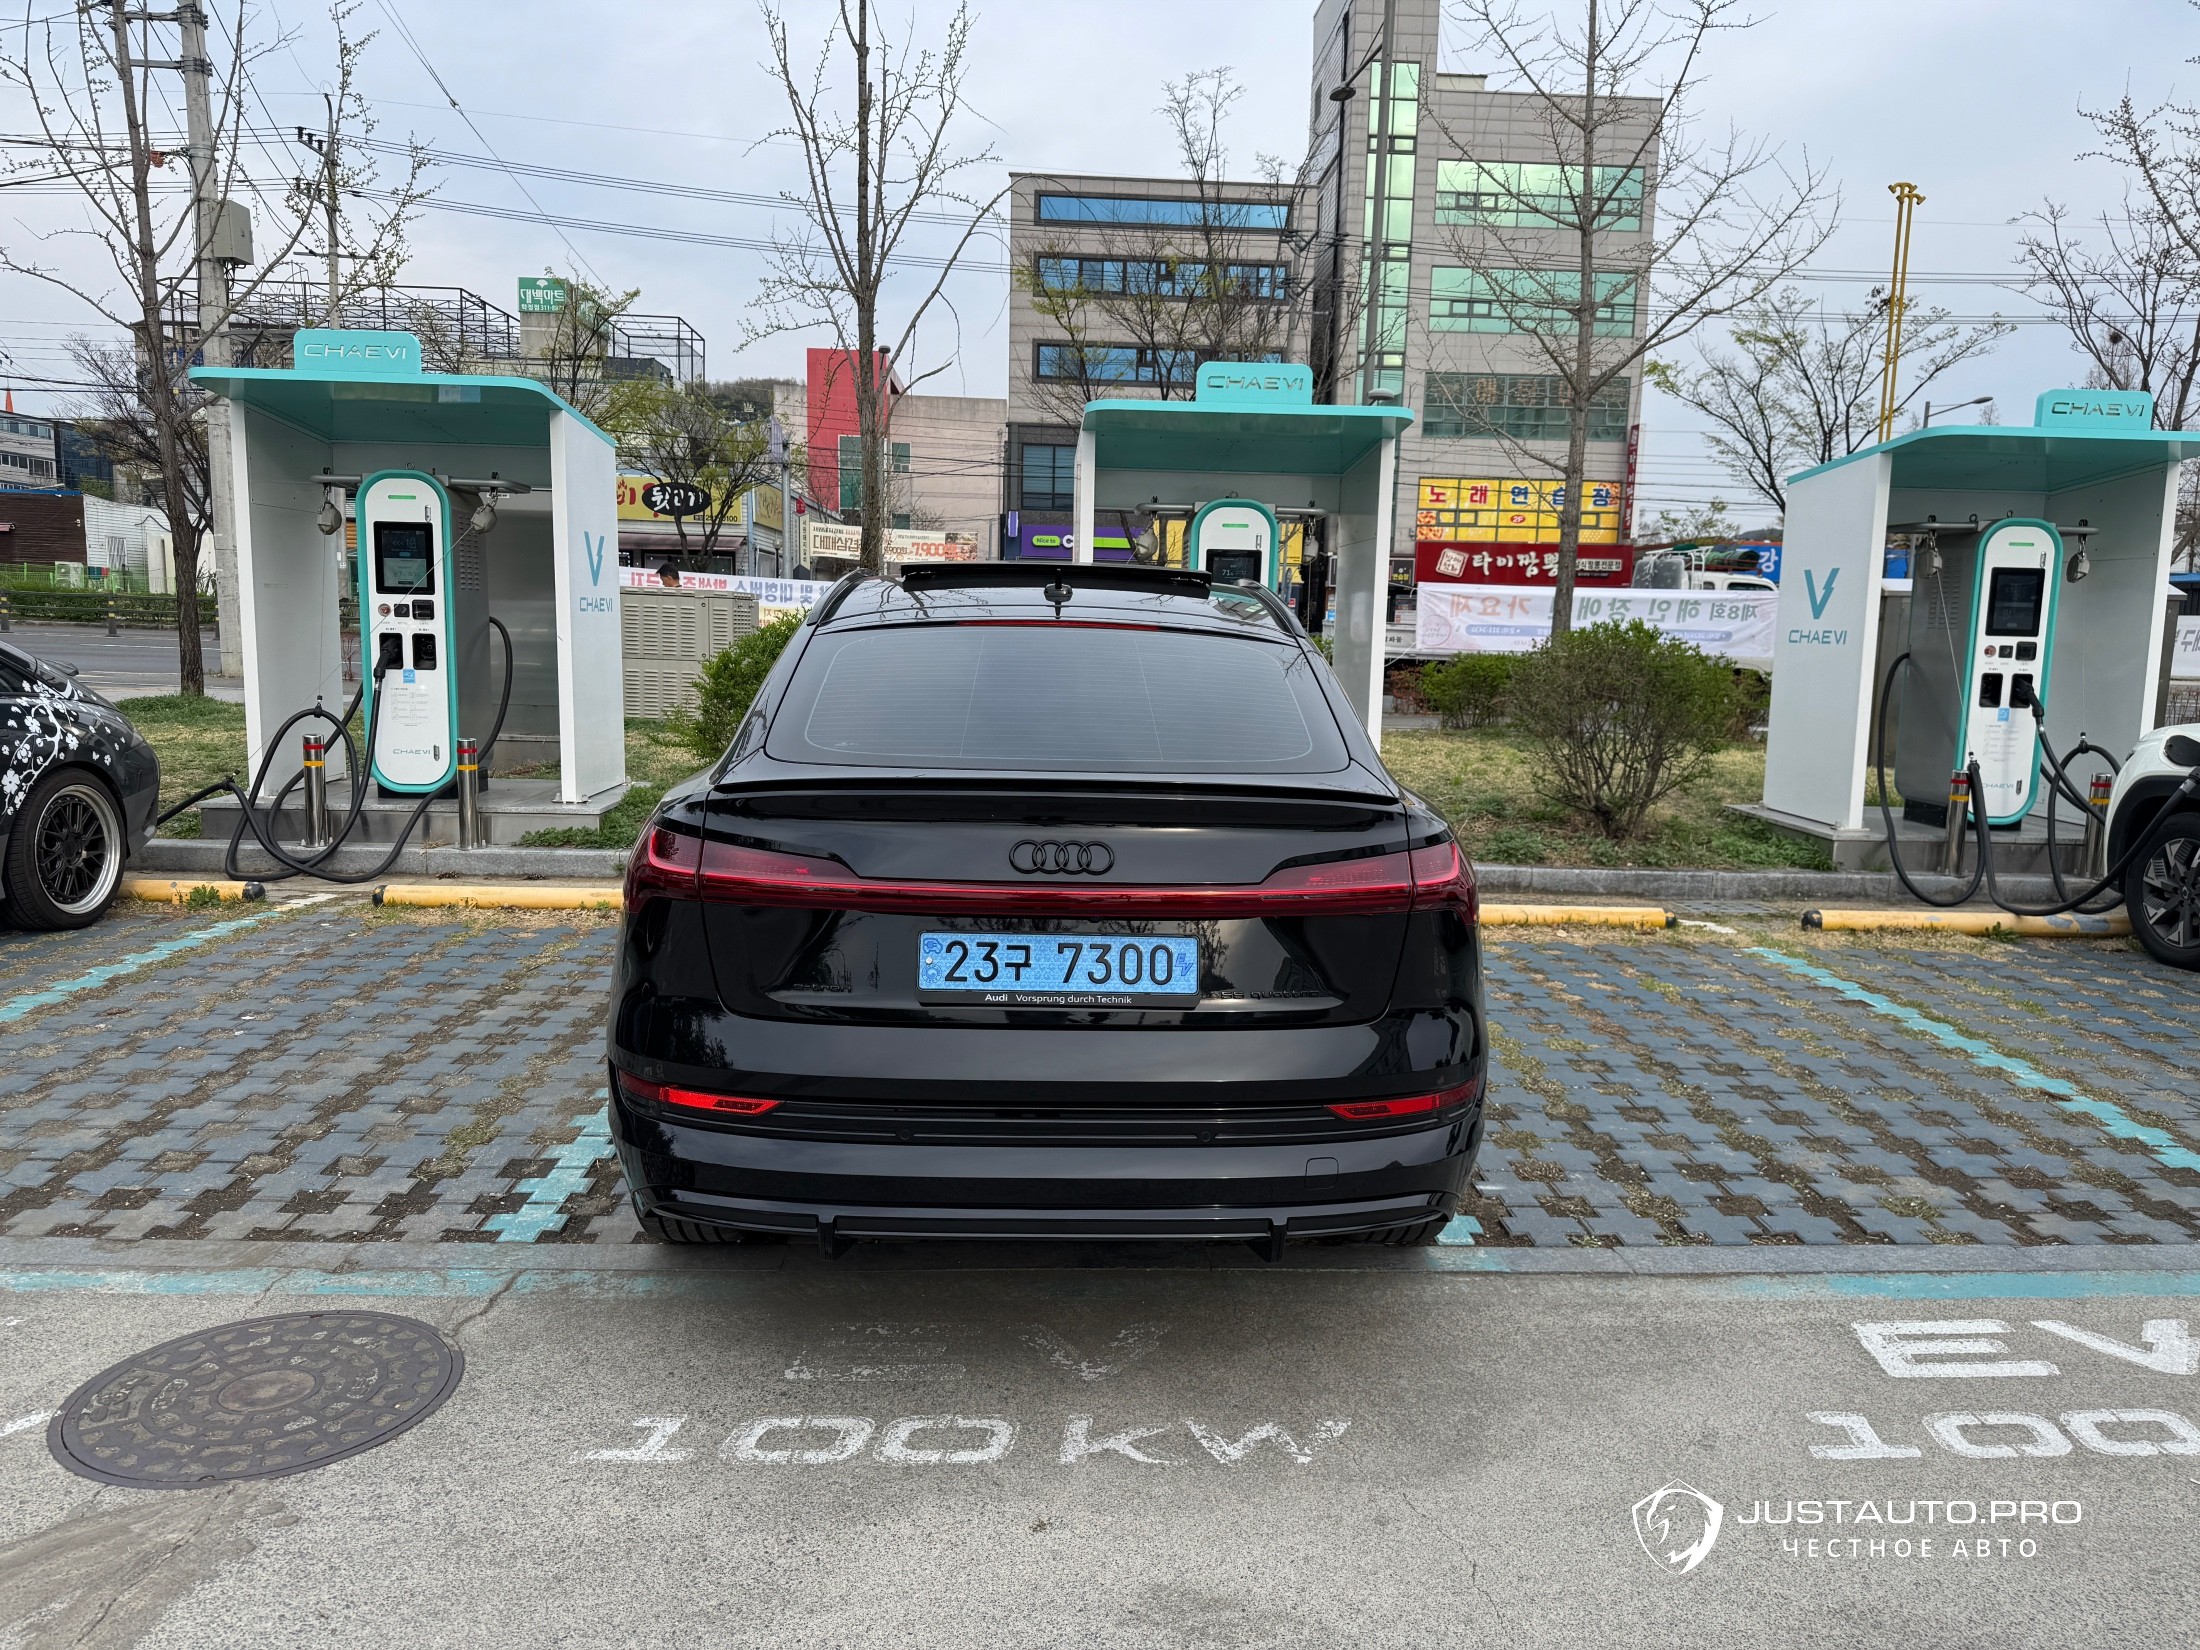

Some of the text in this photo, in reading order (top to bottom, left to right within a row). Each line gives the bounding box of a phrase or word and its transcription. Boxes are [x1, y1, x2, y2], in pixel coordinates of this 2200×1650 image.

[520, 288, 565, 305] 대백마트
[304, 344, 406, 359] CHAEVI
[1207, 375, 1304, 391] CHAEVI
[2051, 401, 2145, 417] CHAEVI
[1512, 515, 1524, 524] 2F
[1471, 550, 1560, 578] 타이짬뽕
[579, 596, 613, 612] CHAEVI
[1788, 629, 1848, 645] CHAEVI
[944, 940, 1173, 985] 23구 7300
[793, 983, 852, 993] e-tron
[1220, 990, 1321, 1001] 55 quattro
[985, 992, 1132, 1004] Audi Vorsprung durch Technik
[1851, 1318, 2200, 1378] EV
[1805, 1408, 2200, 1460] 100
